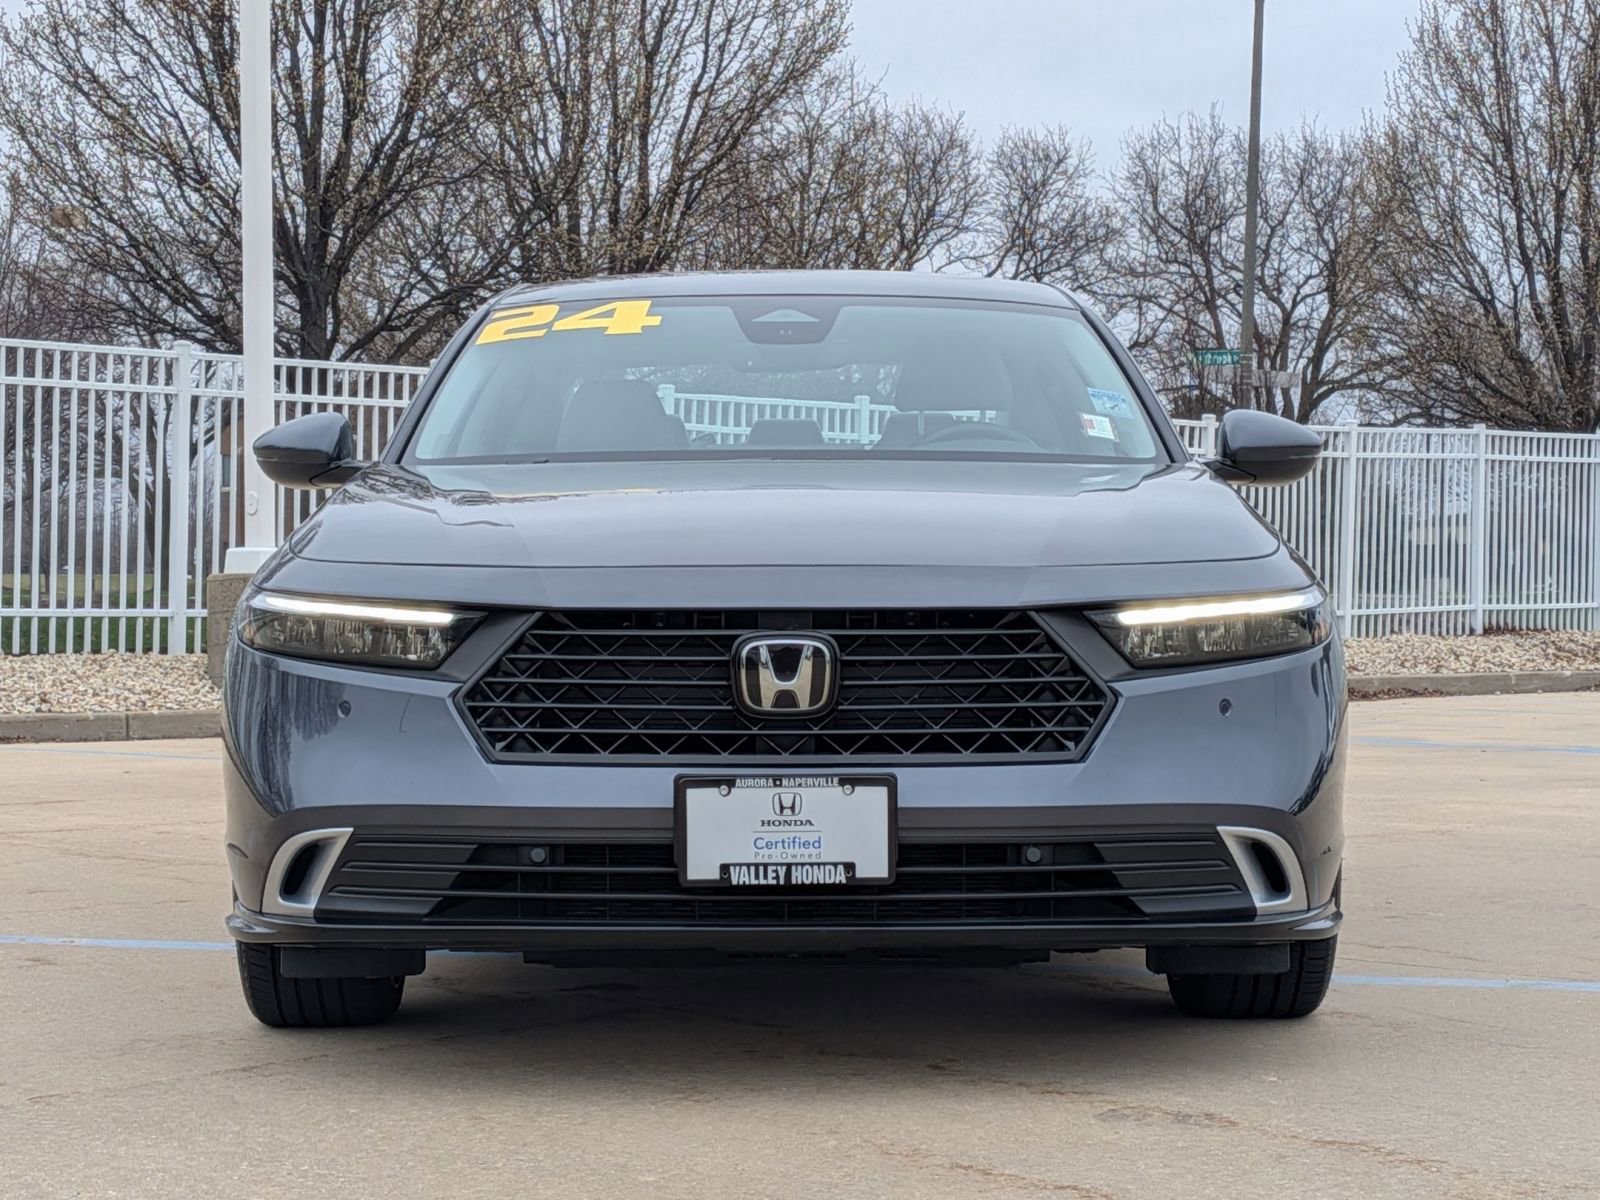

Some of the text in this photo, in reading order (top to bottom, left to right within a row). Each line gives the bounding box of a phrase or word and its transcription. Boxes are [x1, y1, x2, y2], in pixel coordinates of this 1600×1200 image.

[475, 300, 662, 345] 24
[735, 777, 840, 788] AURORA NAPERVILLE
[760, 819, 815, 827] HONDA
[753, 835, 822, 850] Certified
[754, 851, 822, 860] Pre-Owned
[729, 864, 847, 885] VALLEY HONDA
